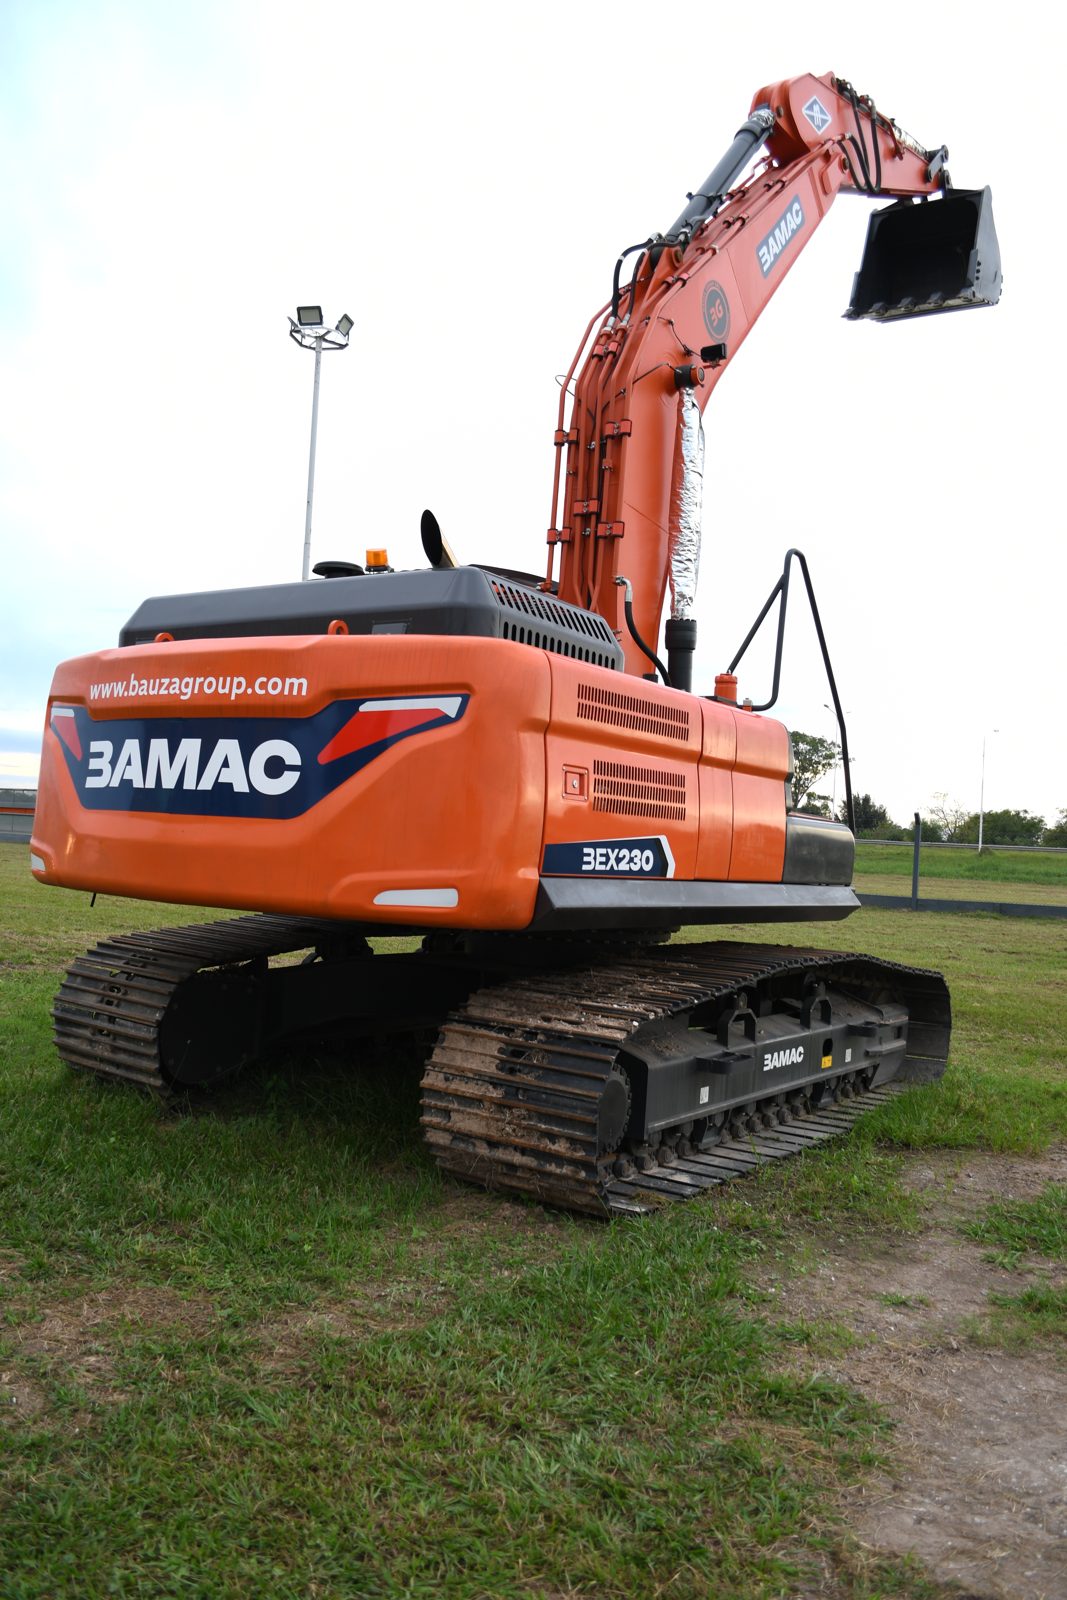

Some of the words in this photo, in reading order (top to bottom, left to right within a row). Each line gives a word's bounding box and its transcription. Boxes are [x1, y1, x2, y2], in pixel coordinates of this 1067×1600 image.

[759, 202, 802, 273] BAMAC
[90, 673, 308, 700] www.bauzagroup.com
[85, 738, 302, 795] BAMAC
[763, 1045, 804, 1071] BAMAC
